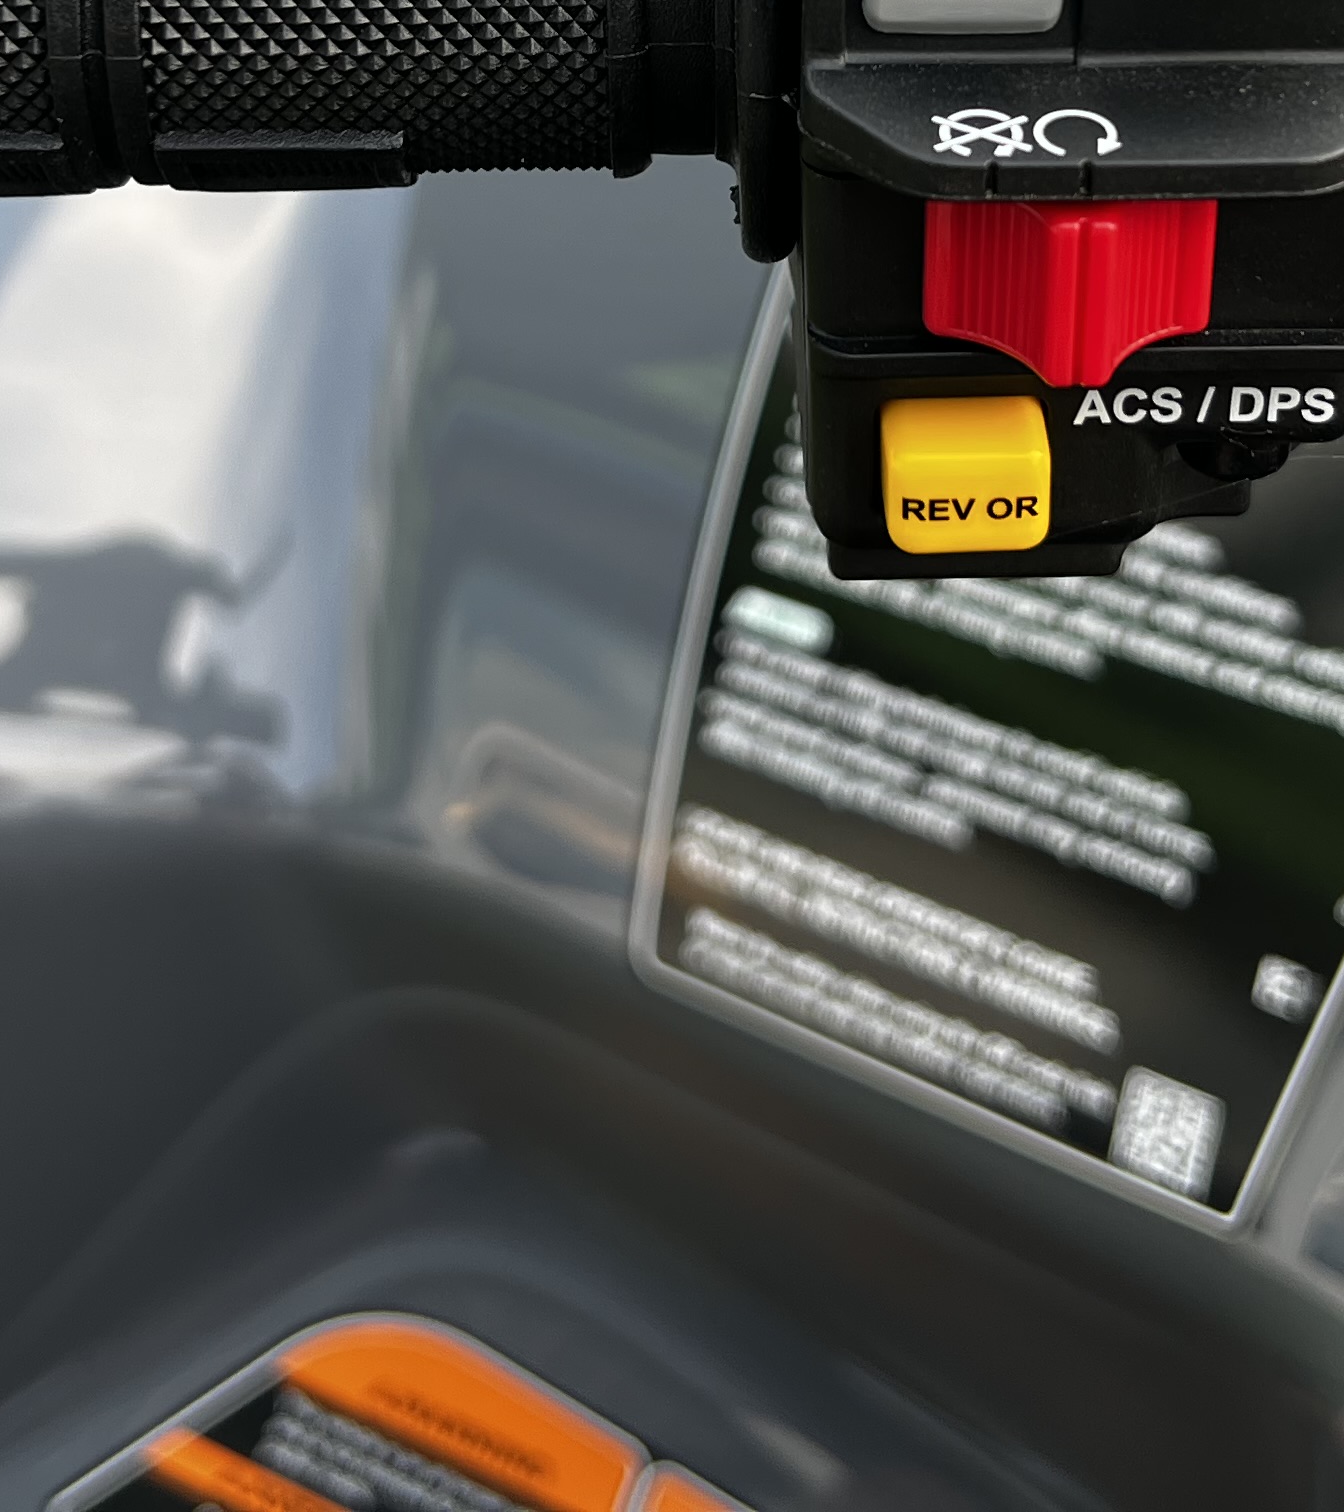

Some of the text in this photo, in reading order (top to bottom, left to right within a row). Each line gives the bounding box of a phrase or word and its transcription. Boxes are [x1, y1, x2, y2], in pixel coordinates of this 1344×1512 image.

[1073, 386, 1336, 426] ACS / DPS
[901, 495, 1039, 522] REV OR
